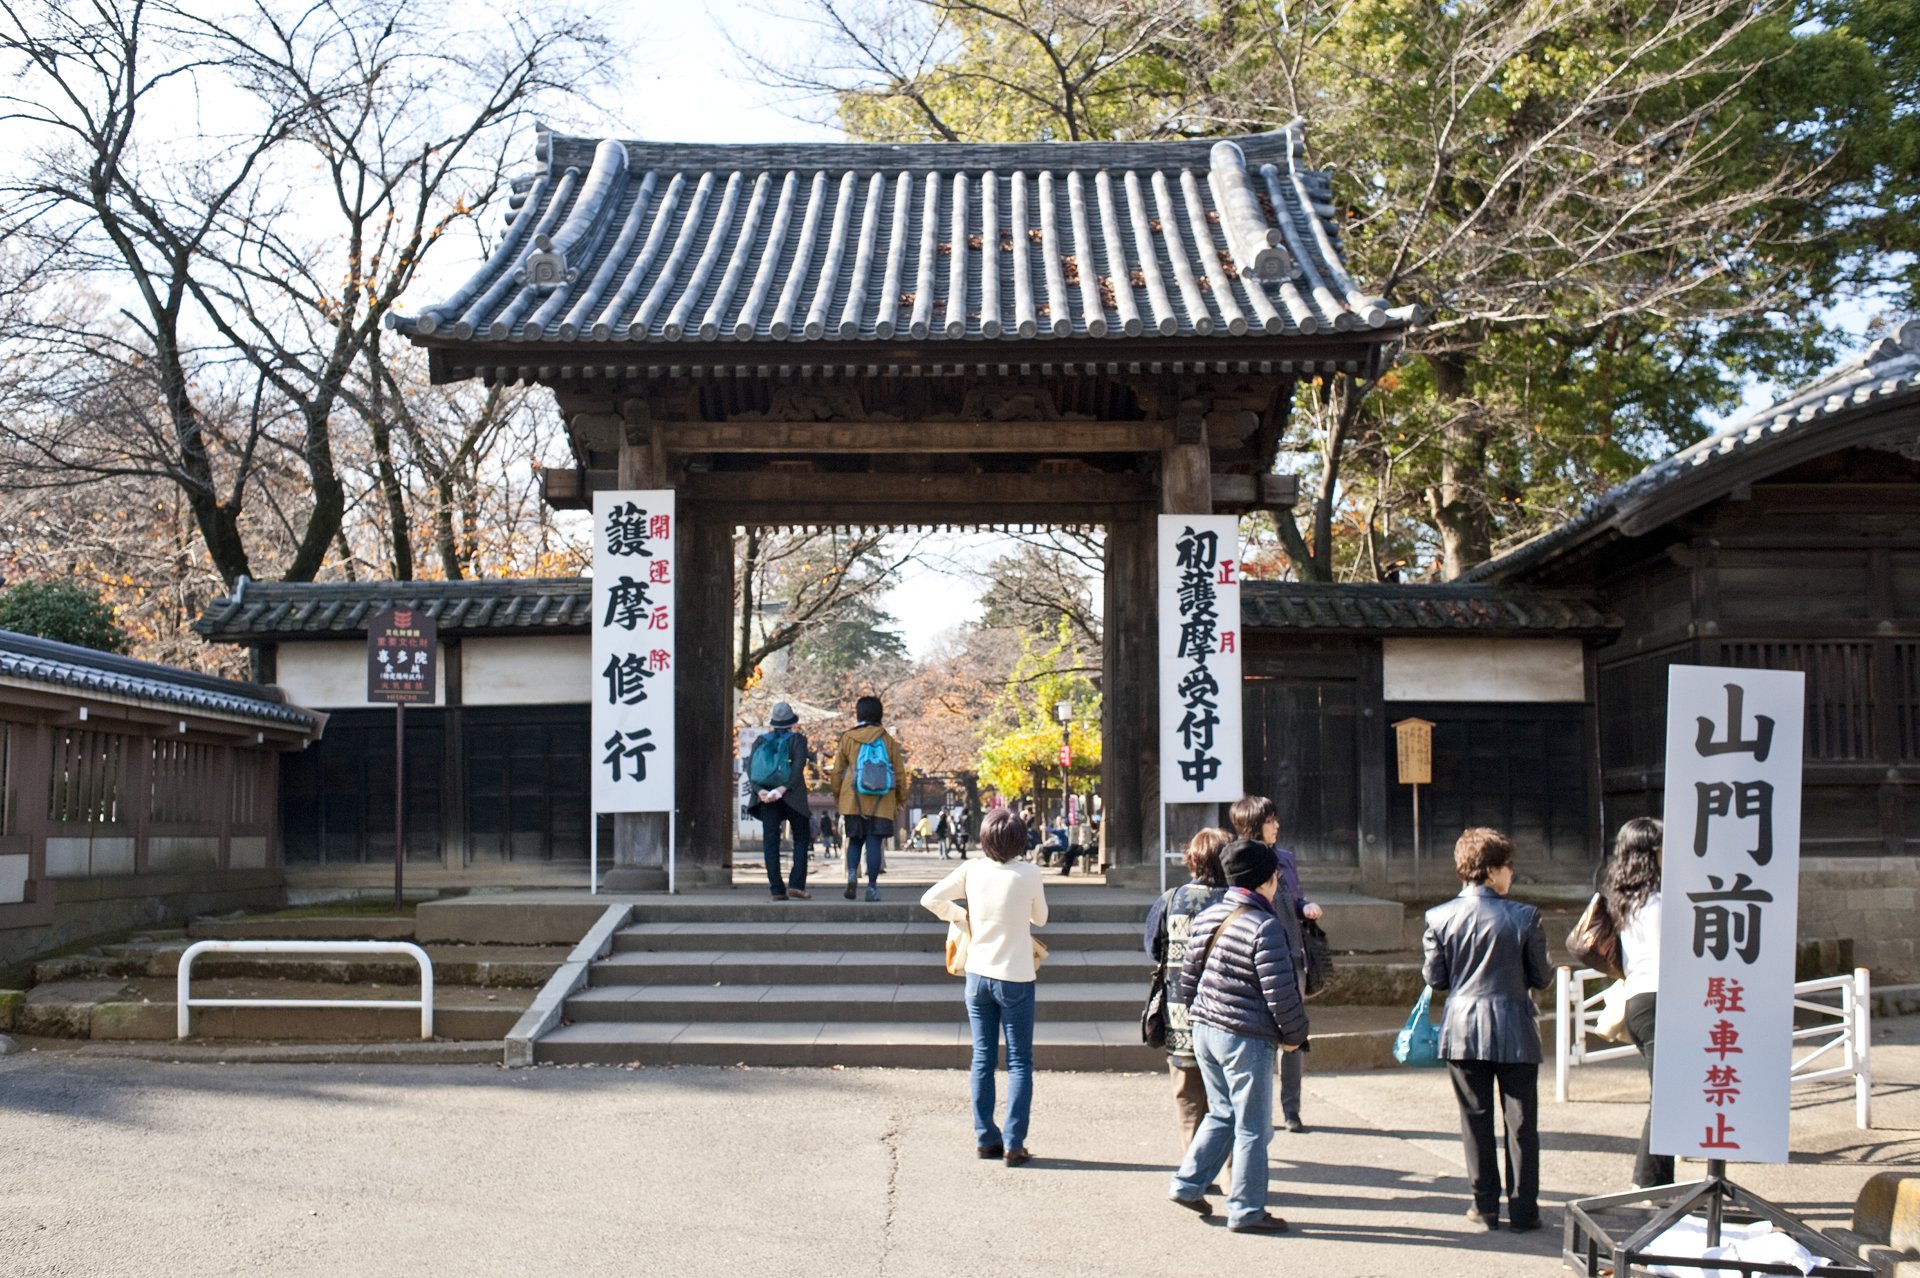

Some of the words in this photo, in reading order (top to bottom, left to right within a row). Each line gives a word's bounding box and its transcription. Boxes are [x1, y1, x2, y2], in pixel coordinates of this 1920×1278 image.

[377, 649, 428, 664] 喜多院
[602, 501, 656, 783] 護摩修行
[647, 514, 671, 671] 開運厄除
[1175, 525, 1223, 794] 初護摩受付中
[1216, 559, 1238, 654] 正月
[1686, 683, 1776, 965] 山門前
[1699, 977, 1746, 1150] 駐車禁止
